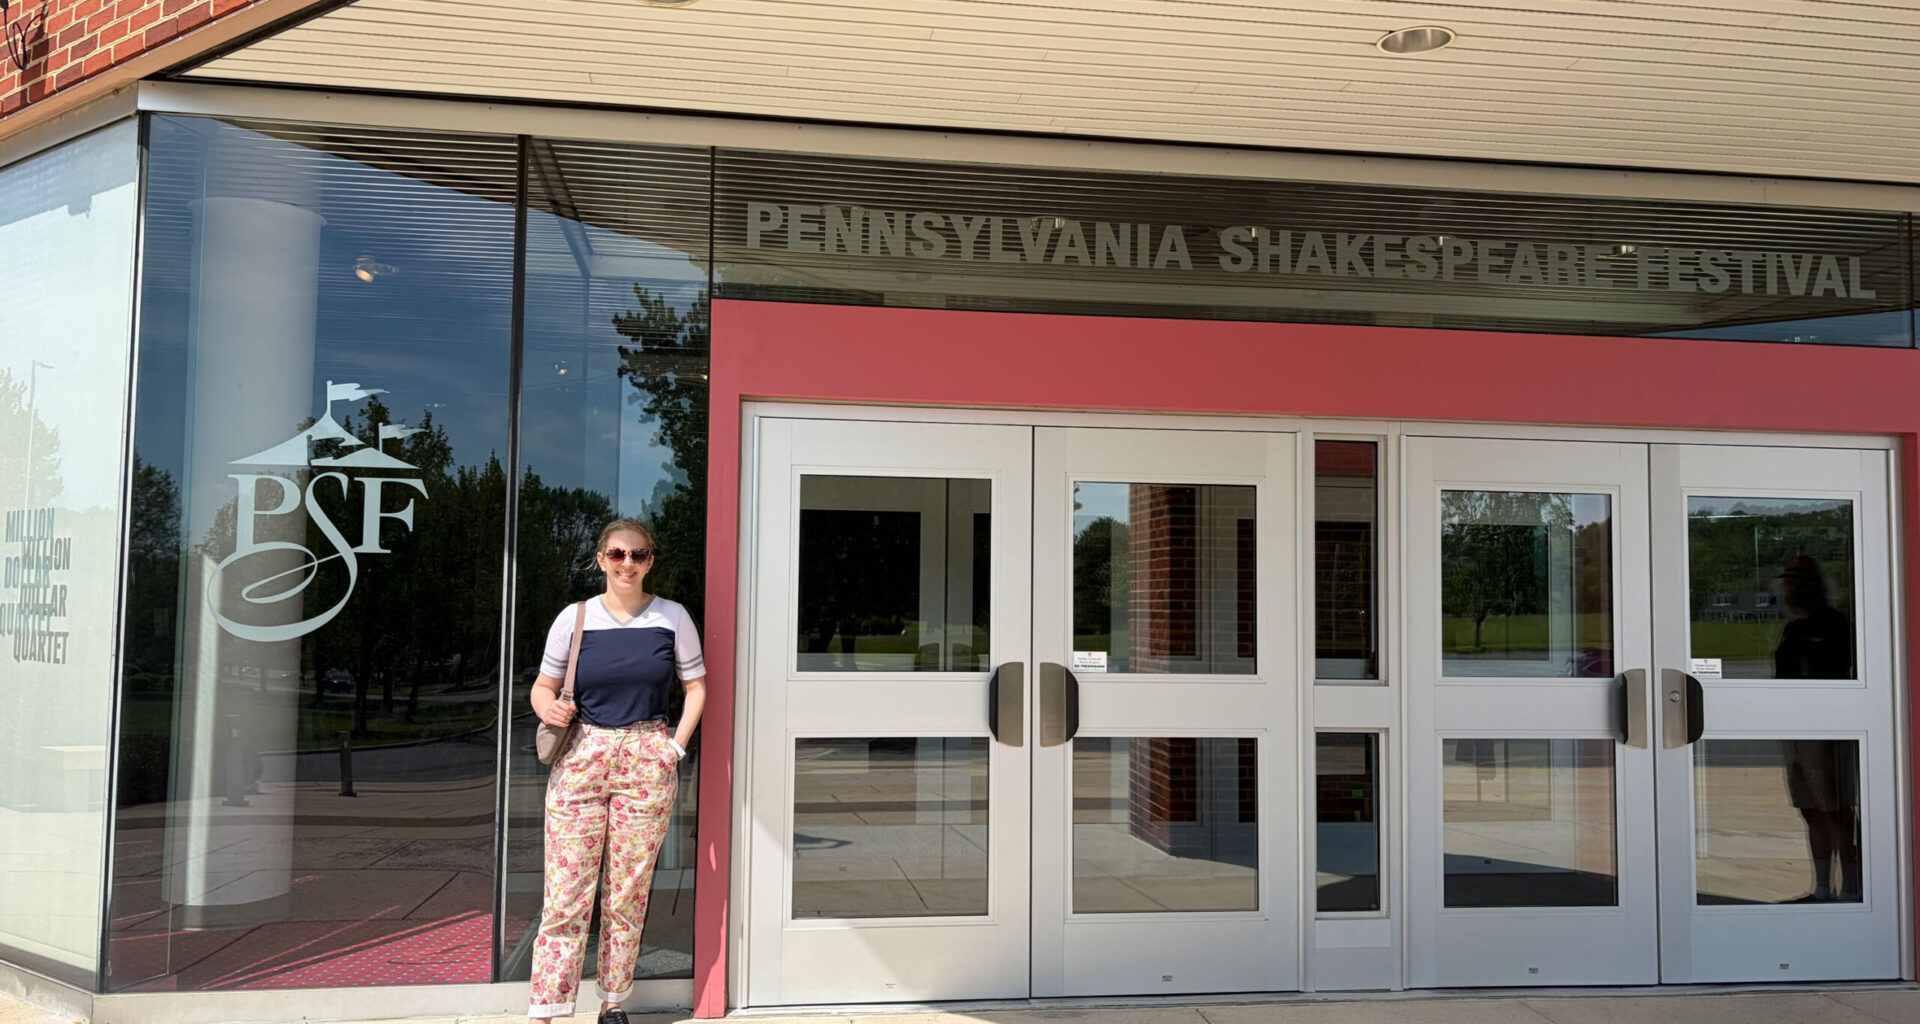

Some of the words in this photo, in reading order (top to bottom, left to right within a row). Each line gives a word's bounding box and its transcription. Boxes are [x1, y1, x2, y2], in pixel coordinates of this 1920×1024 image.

[747, 202, 1193, 271] PENNSYLVANIA
[1218, 227, 1613, 286] SHAKESPEARE
[1637, 247, 1876, 298] FESTIVAL
[5, 508, 55, 542] MILLION
[4, 556, 51, 589] DOLLAR
[207, 472, 429, 642] PSF
[0, 603, 53, 637] QUARTET
[13, 632, 69, 665] QUARTET
